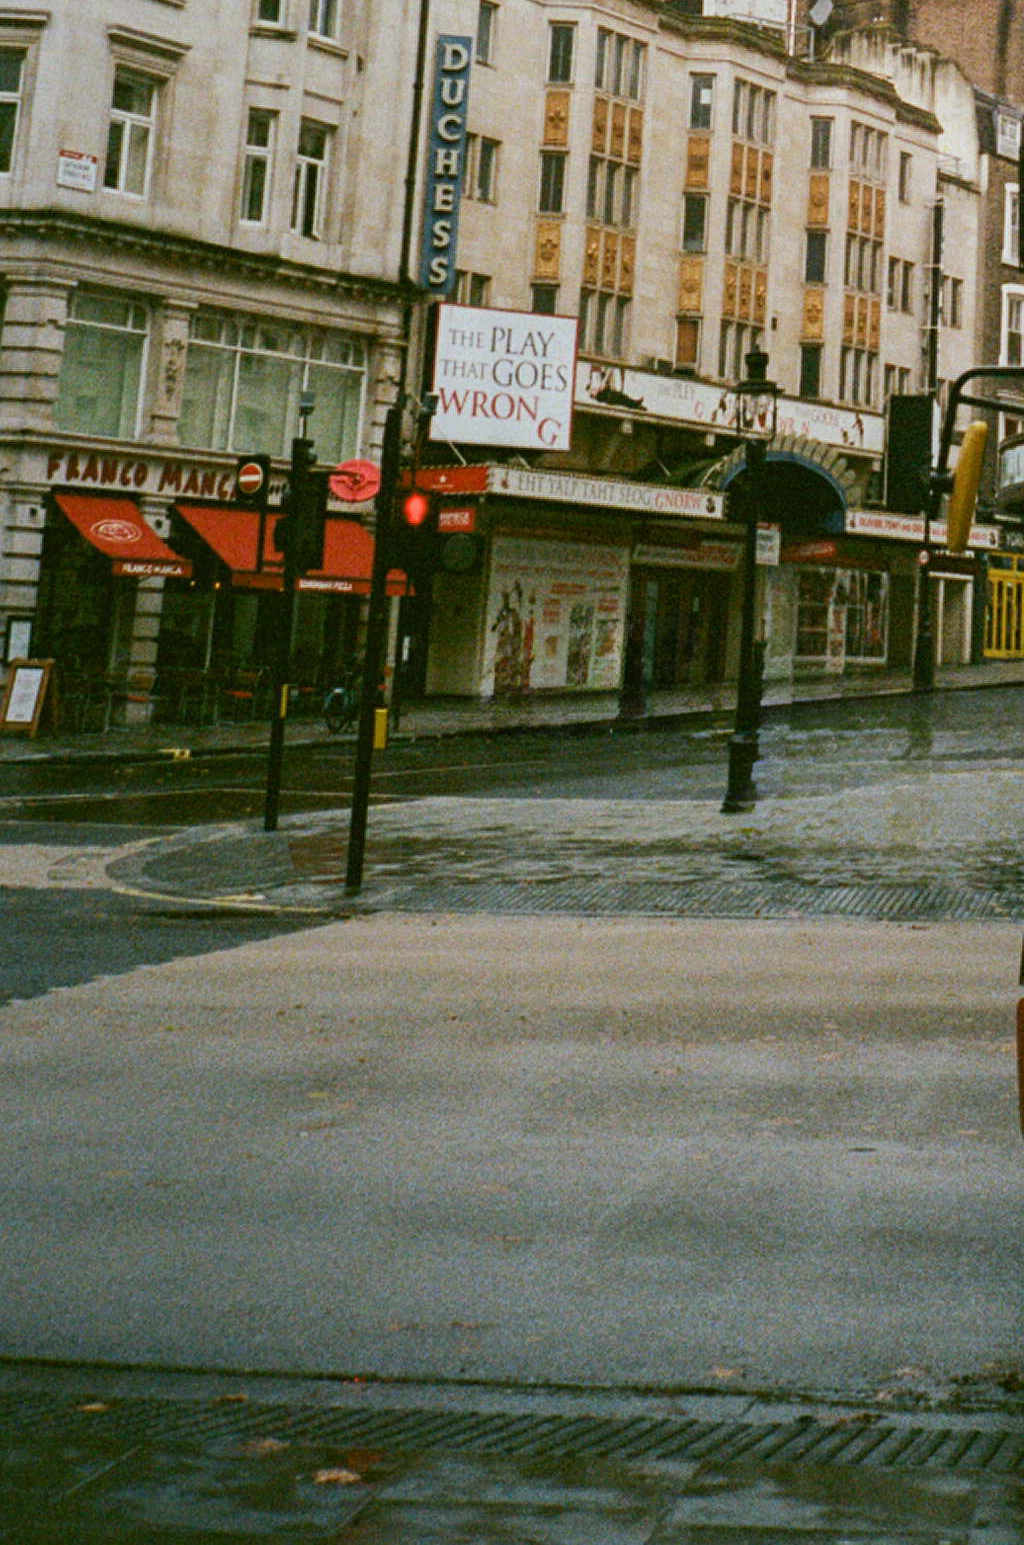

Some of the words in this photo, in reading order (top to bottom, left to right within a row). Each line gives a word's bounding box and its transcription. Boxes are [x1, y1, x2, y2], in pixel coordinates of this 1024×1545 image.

[429, 42, 469, 285] DUCHESS
[449, 328, 486, 349] THE
[490, 326, 556, 358] PLAY
[440, 358, 489, 380] THAT
[492, 358, 568, 392] GOES
[438, 386, 562, 446] WRONG
[46, 453, 149, 487] FRANCO
[517, 473, 546, 493] EHT
[550, 477, 578, 498] YALP
[581, 482, 615, 502] TAHT
[655, 492, 701, 511] GNORW
